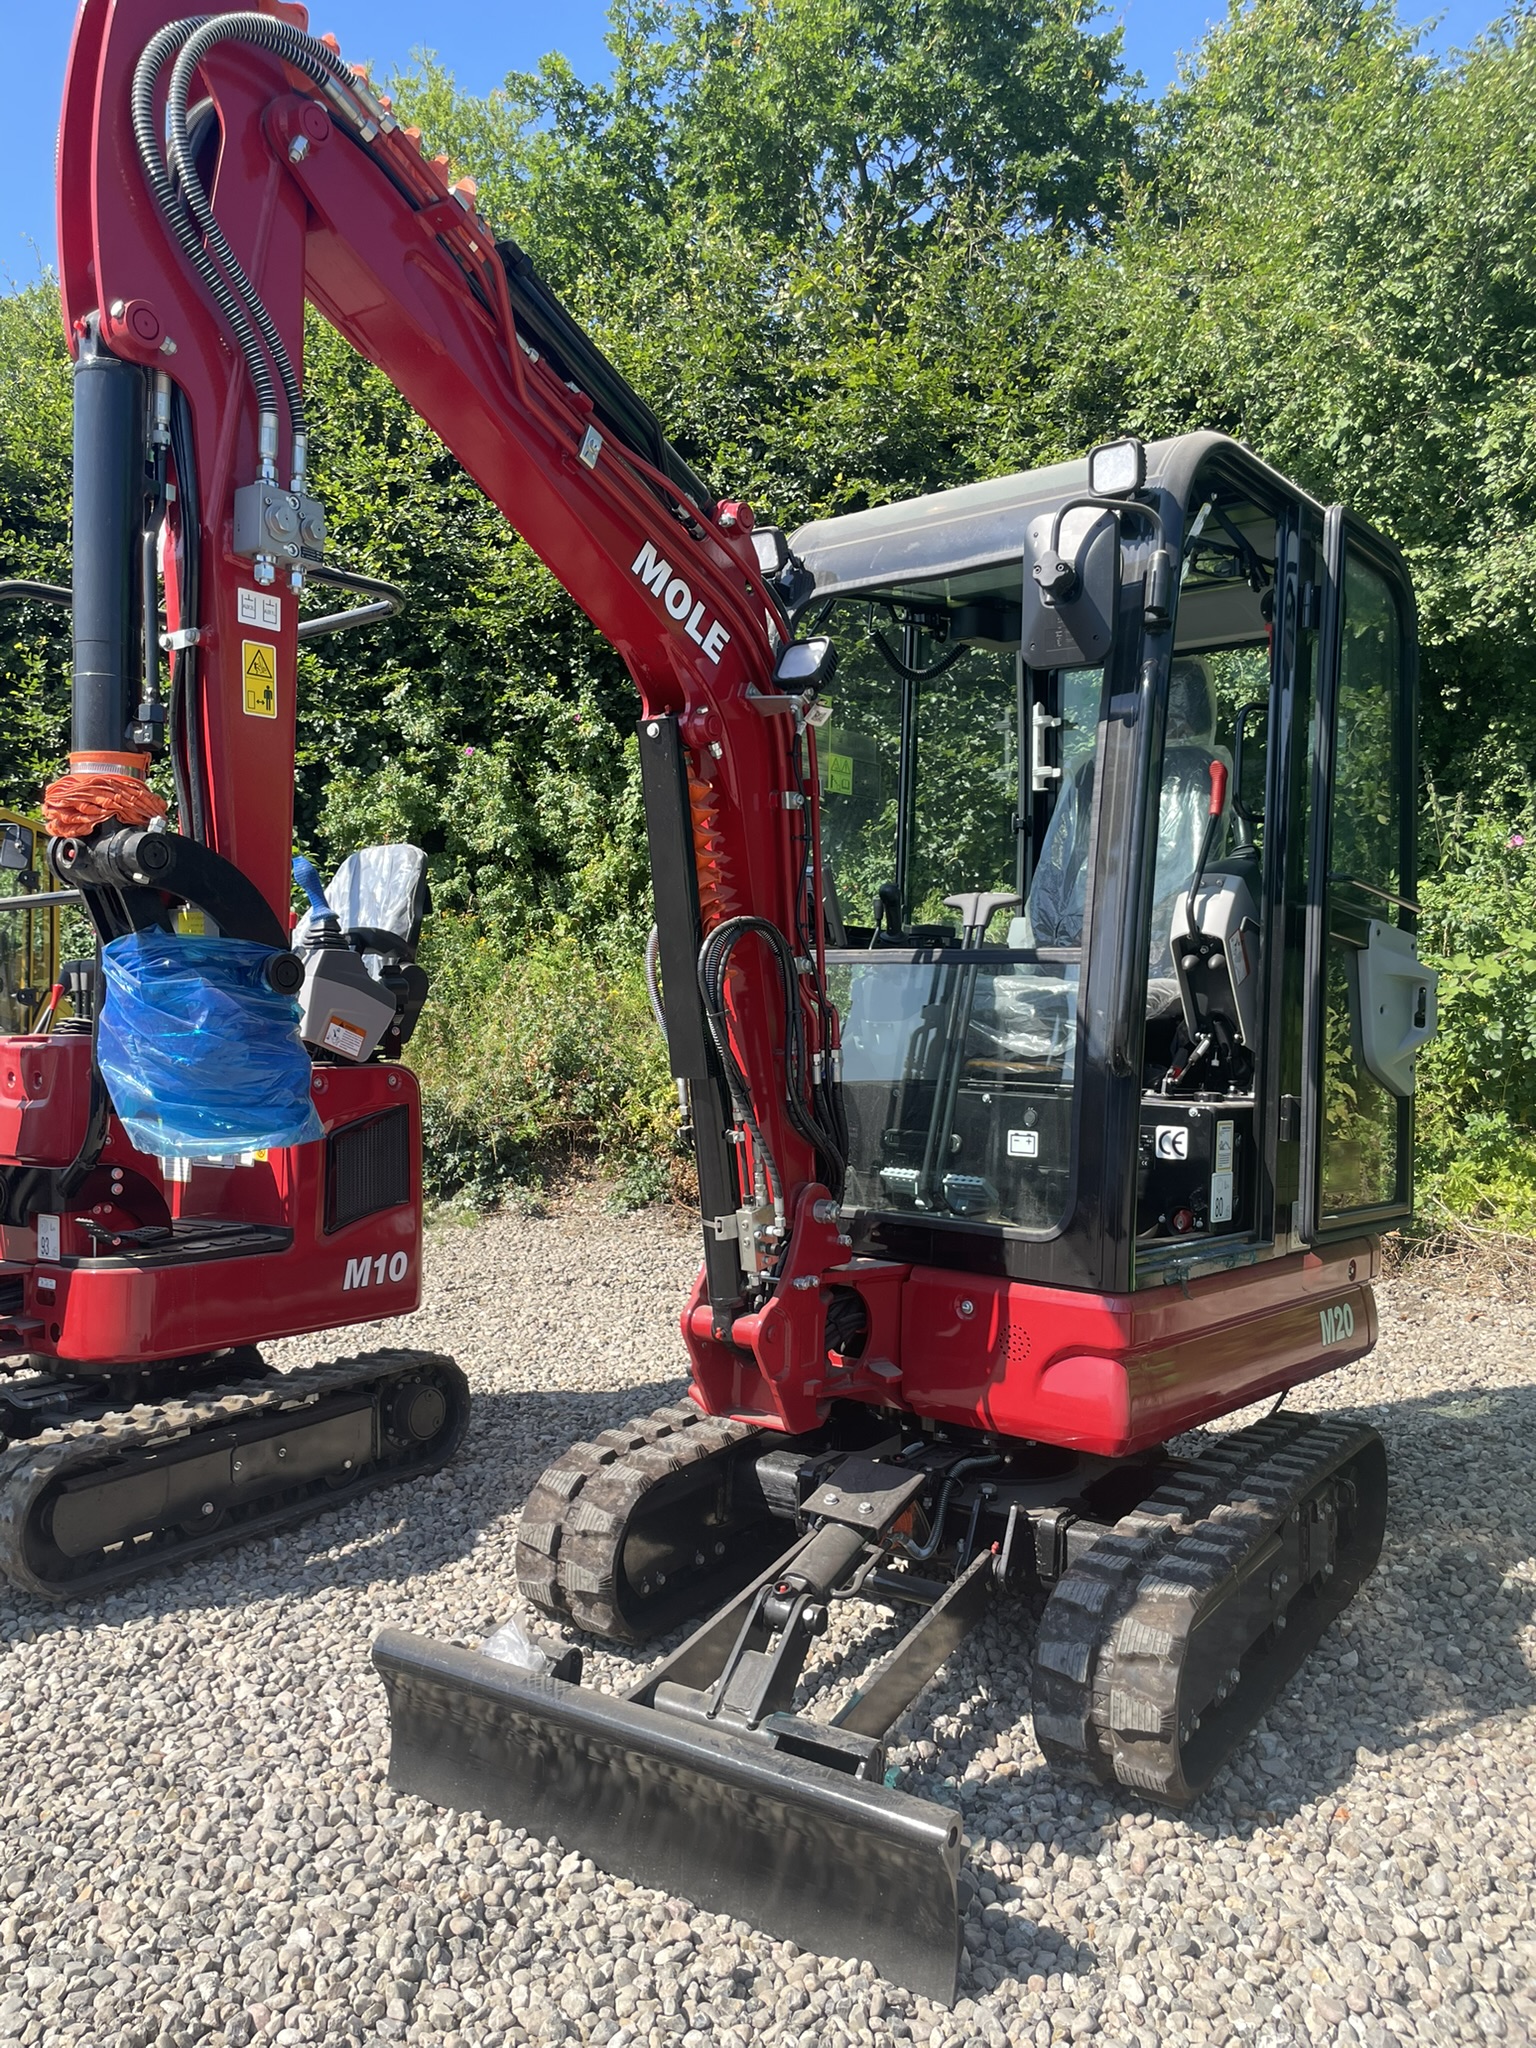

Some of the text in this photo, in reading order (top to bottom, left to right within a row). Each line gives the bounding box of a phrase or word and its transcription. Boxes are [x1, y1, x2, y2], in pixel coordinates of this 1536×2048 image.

[630, 540, 731, 665] MOLE
[1158, 1130, 1185, 1157] CE
[1215, 1197, 1224, 1218] 80
[40, 1236, 50, 1255] 93
[343, 1251, 408, 1290] M10
[1319, 1303, 1354, 1346] M20
